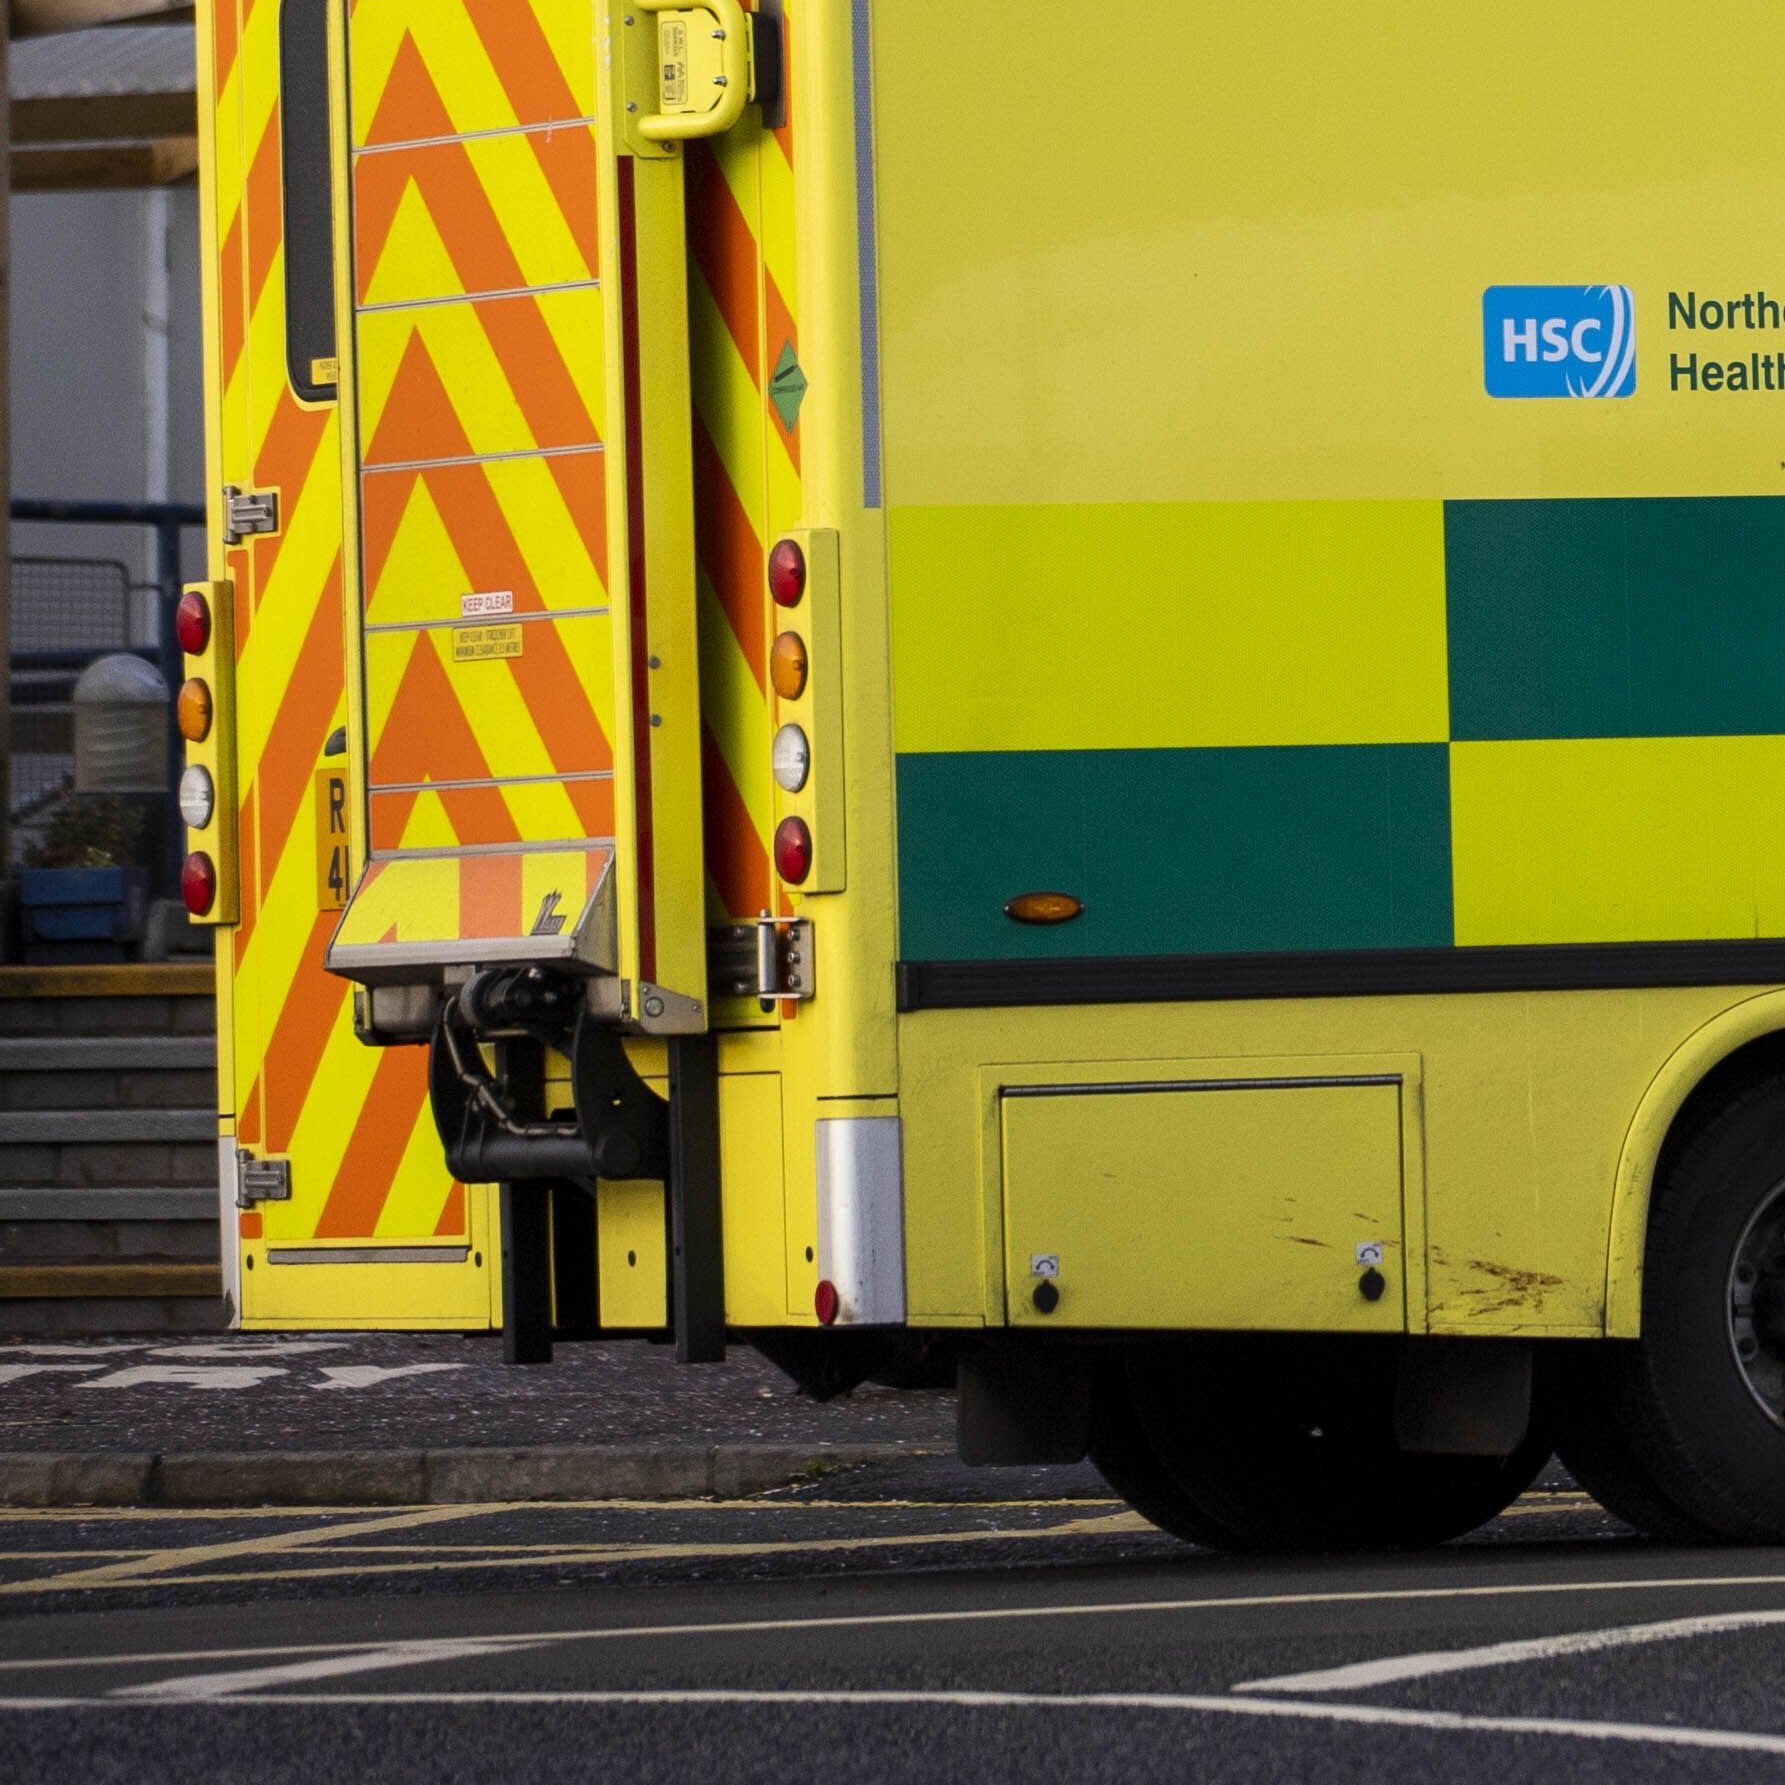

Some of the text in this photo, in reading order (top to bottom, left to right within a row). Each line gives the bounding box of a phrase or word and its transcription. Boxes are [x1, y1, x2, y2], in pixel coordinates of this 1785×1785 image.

[1502, 317, 1602, 363] HSC
[463, 594, 512, 612] KEEP CLEAR
[329, 777, 345, 834] R
